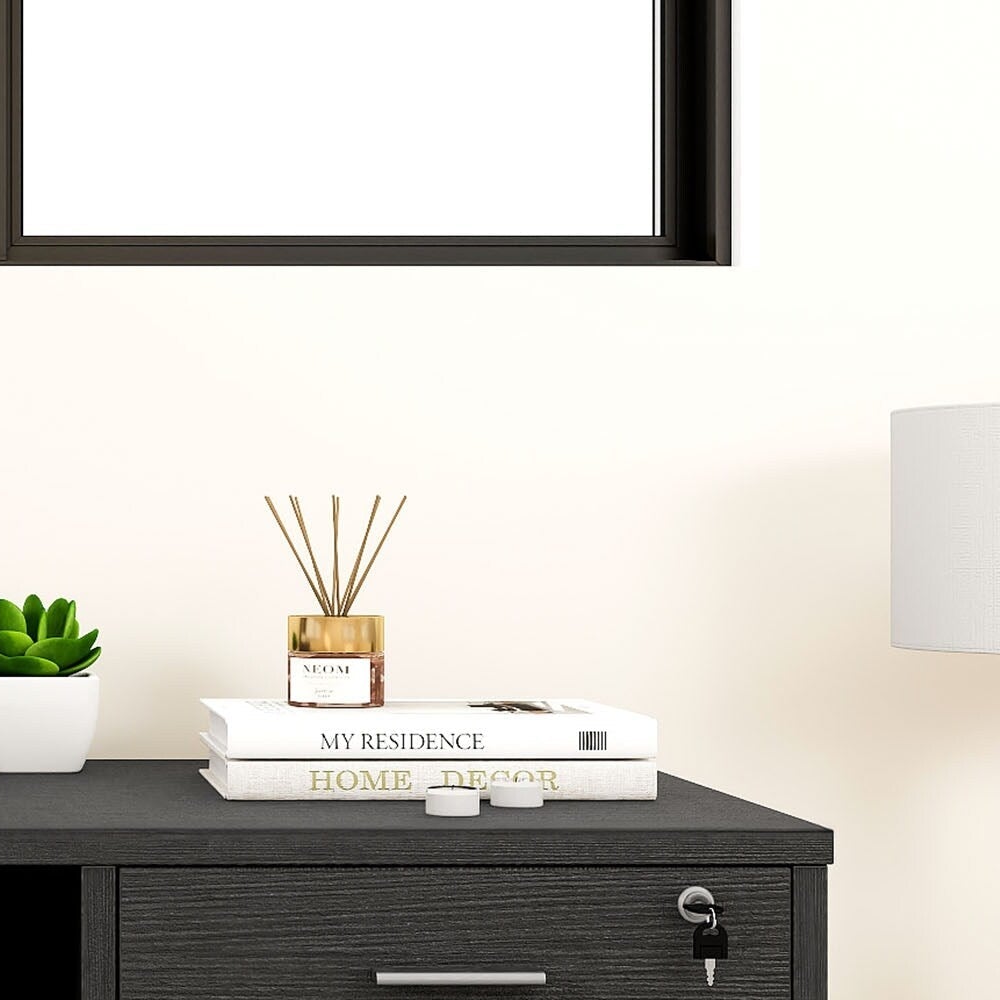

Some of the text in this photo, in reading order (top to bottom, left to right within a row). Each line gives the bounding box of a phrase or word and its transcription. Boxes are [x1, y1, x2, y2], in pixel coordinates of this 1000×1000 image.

[303, 664, 350, 674] NEOM
[320, 733, 485, 750] MY RESIDENCE
[309, 770, 412, 790] HOME
